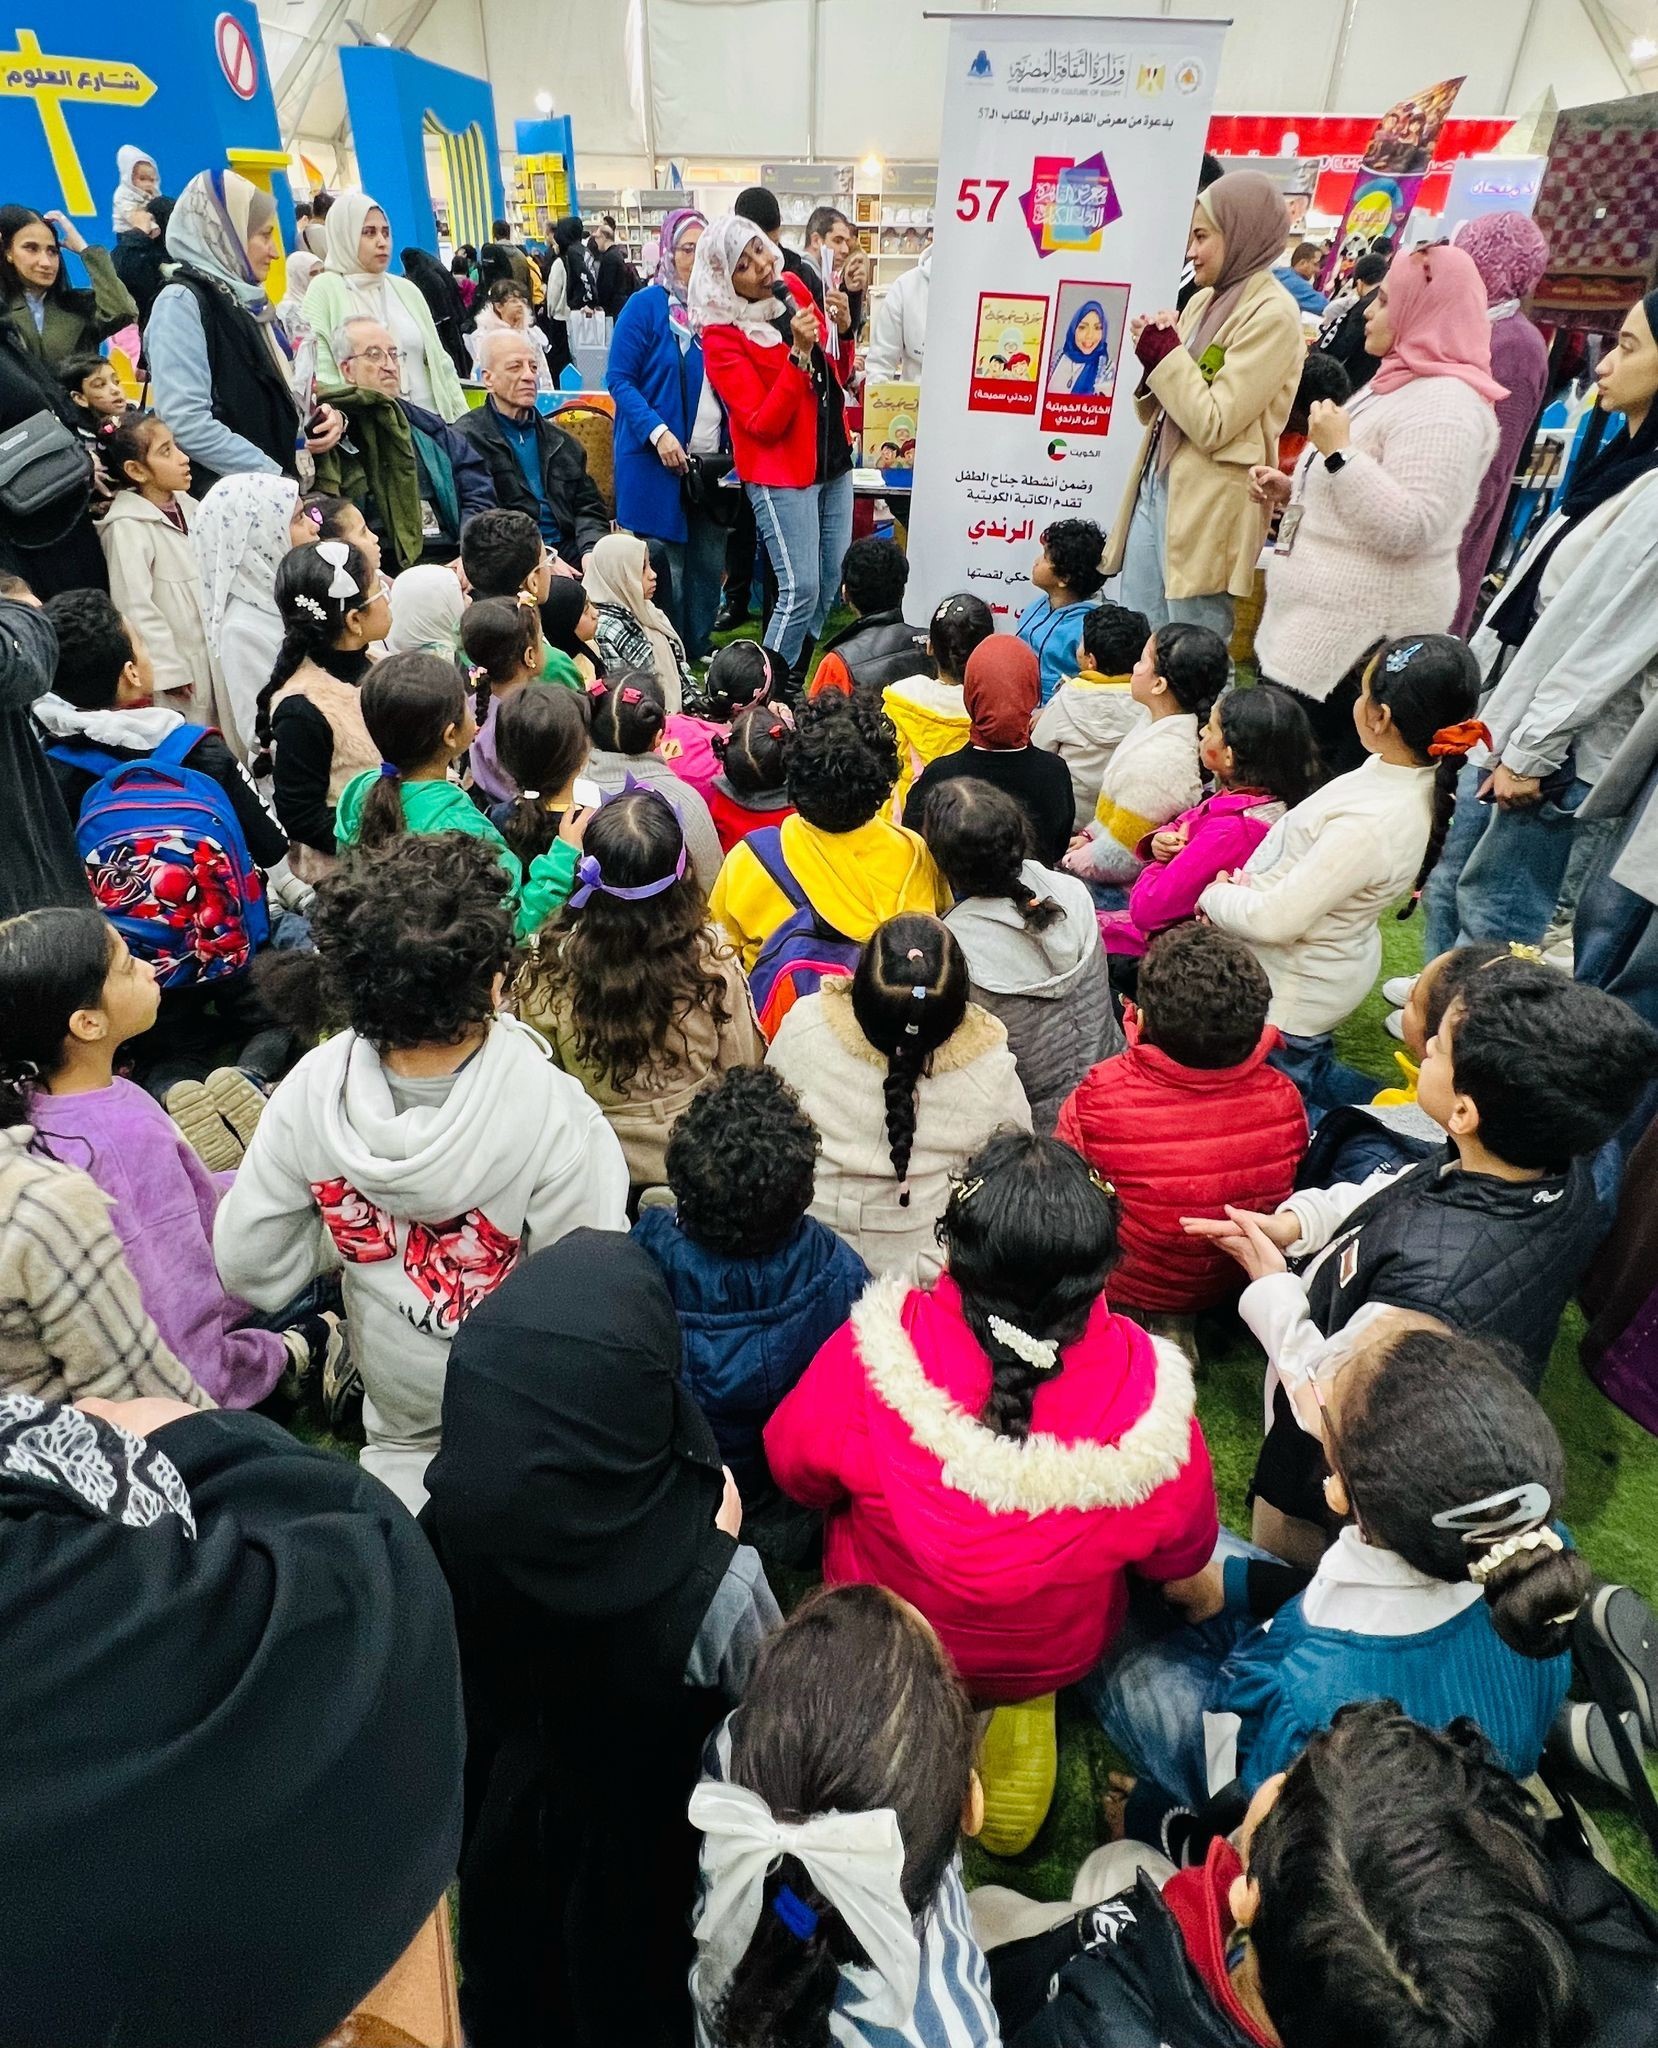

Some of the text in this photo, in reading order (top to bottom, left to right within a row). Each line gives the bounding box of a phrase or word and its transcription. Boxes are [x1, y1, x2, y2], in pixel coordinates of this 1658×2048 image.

[1006, 47, 1126, 86] وزارة الثقافة المصرية
[6, 67, 141, 92] شارع العلوم
[1008, 84, 1020, 92] THE
[1051, 87, 1060, 95] OF
[1061, 87, 1089, 96] CULTURE
[1001, 109, 1031, 124] للكتاب
[1031, 110, 1062, 126] الدولي
[1063, 111, 1096, 126] القاهرة
[1096, 113, 1127, 128] معرض
[1128, 116, 1142, 129] من
[1143, 115, 1174, 131] بدعوة
[956, 178, 1010, 223] 57
[1045, 400, 1112, 415] الكاتبة الكويتية
[1055, 415, 1098, 426] أمل الرندي
[1070, 449, 1101, 458] الكويت
[955, 470, 1093, 494] وضمن أنشطة جناح الطفل
[967, 488, 1082, 509] تقدم الكاتبة الكويتية
[967, 516, 1034, 545] الرندي
[966, 568, 1003, 580] لقصتها
